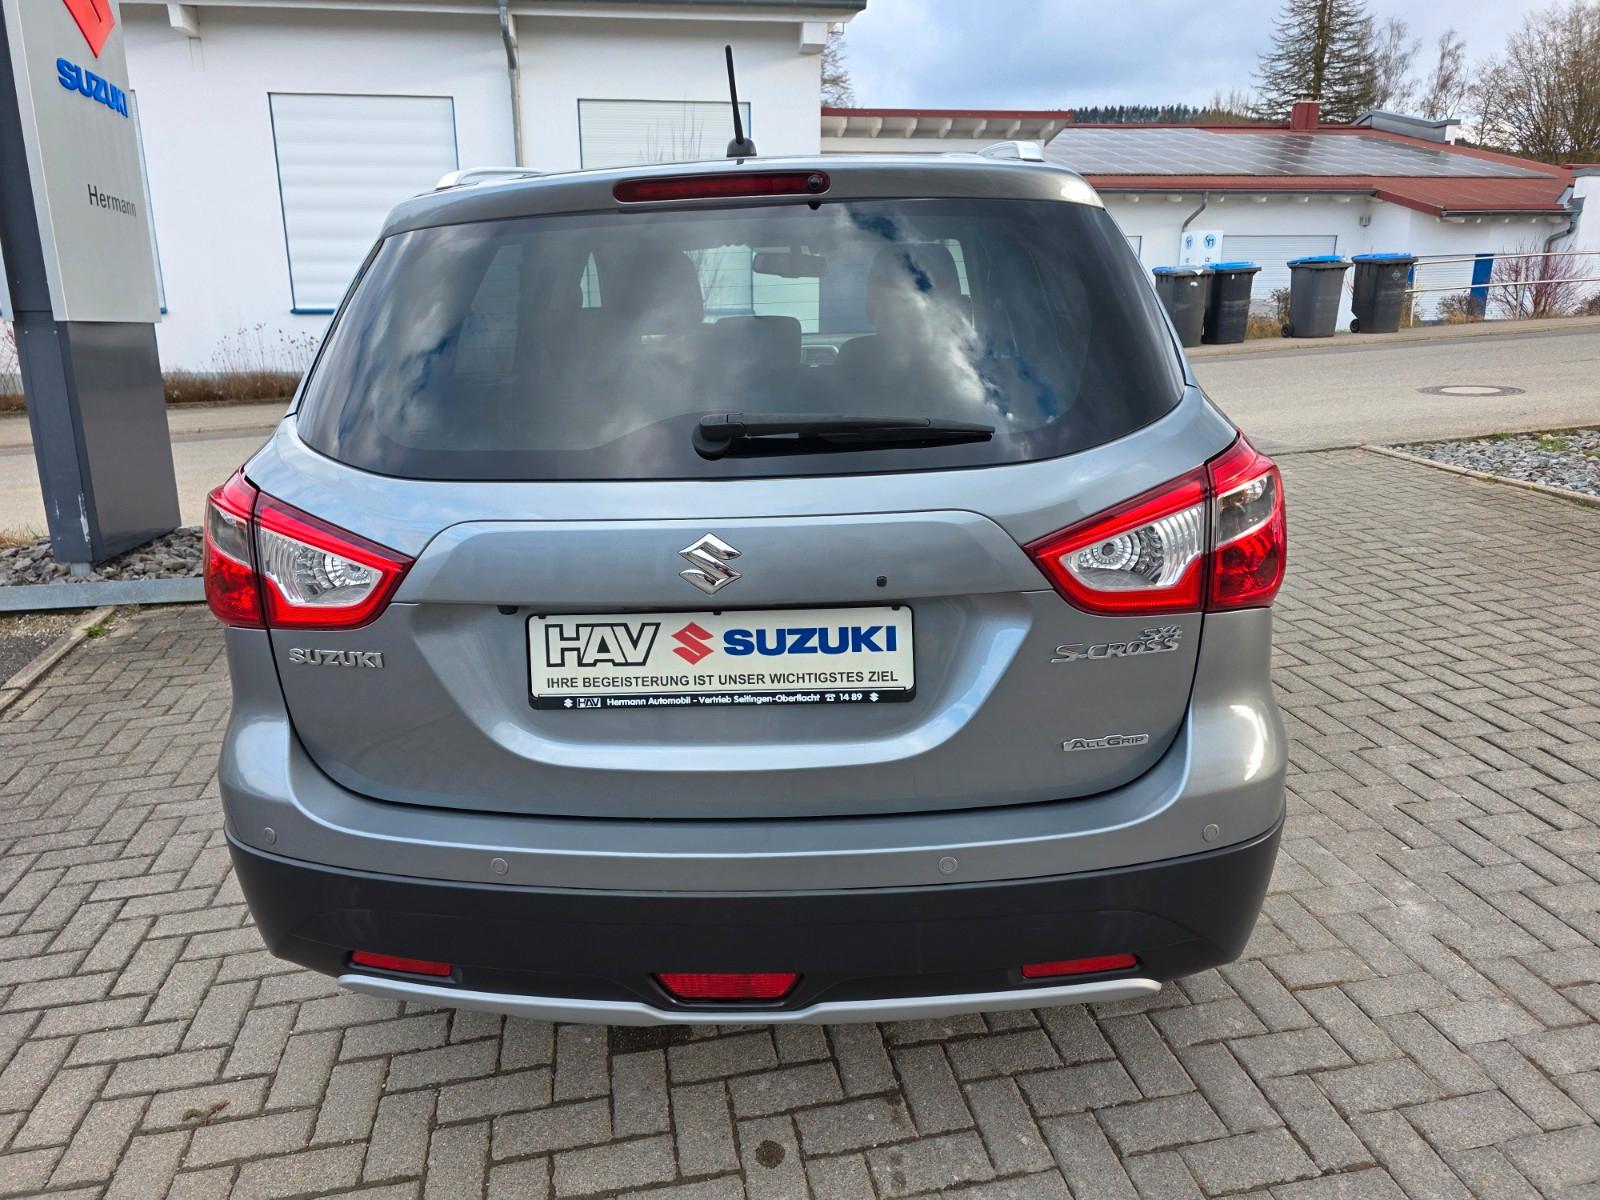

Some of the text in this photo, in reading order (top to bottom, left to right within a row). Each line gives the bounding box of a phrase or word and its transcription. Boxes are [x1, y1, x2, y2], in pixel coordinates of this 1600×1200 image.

[56, 57, 129, 118] SUZUKI
[87, 184, 137, 217] Hermann
[545, 621, 897, 667] HAV SUZUKI
[1050, 638, 1179, 663] S-CROSS
[289, 647, 385, 669] SUZUKI
[547, 671, 898, 688] IHRE BEGEISTERUNG IST UNSER WICHTIGSTES ZIEL
[607, 698, 646, 706] Hermann
[648, 696, 691, 705] Automobil
[698, 695, 731, 704] Vertrieb
